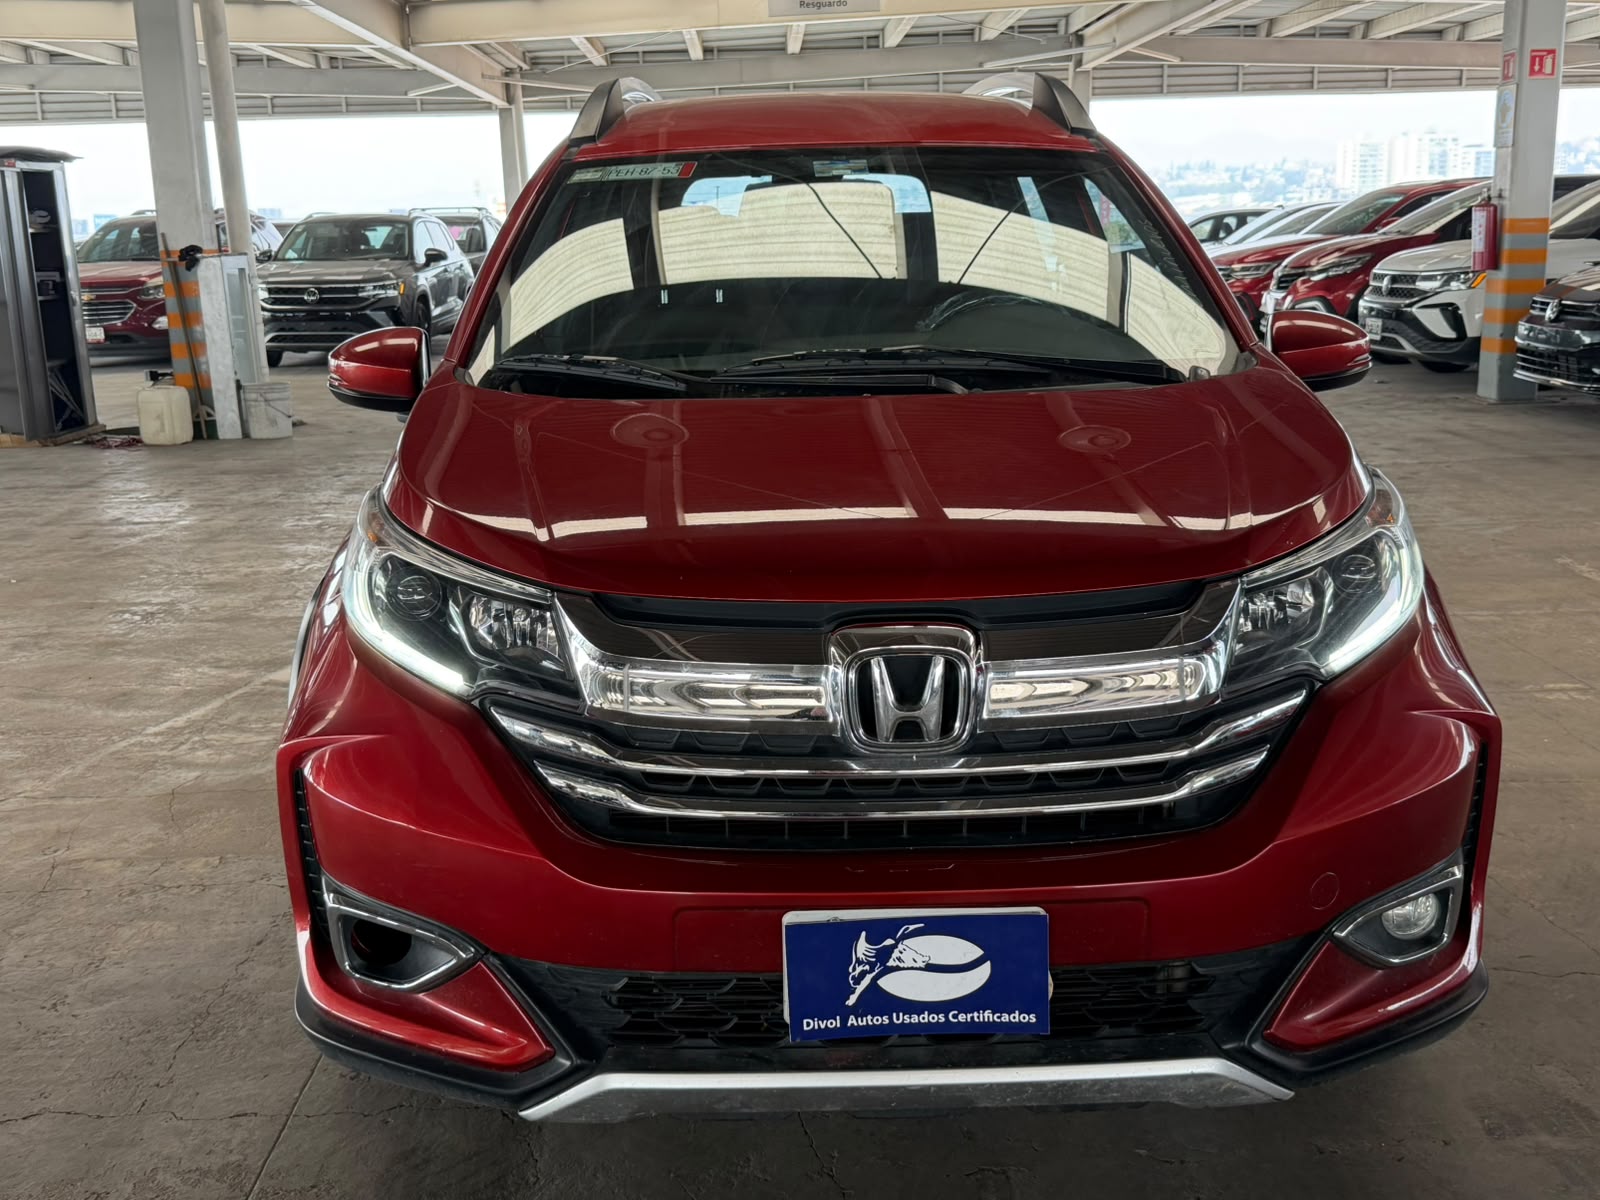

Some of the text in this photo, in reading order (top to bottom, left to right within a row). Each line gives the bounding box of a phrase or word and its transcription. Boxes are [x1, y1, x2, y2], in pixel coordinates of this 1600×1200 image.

[799, 0, 848, 10] Resguardo
[803, 1010, 1037, 1031] Divol Autos Usados Certificados
